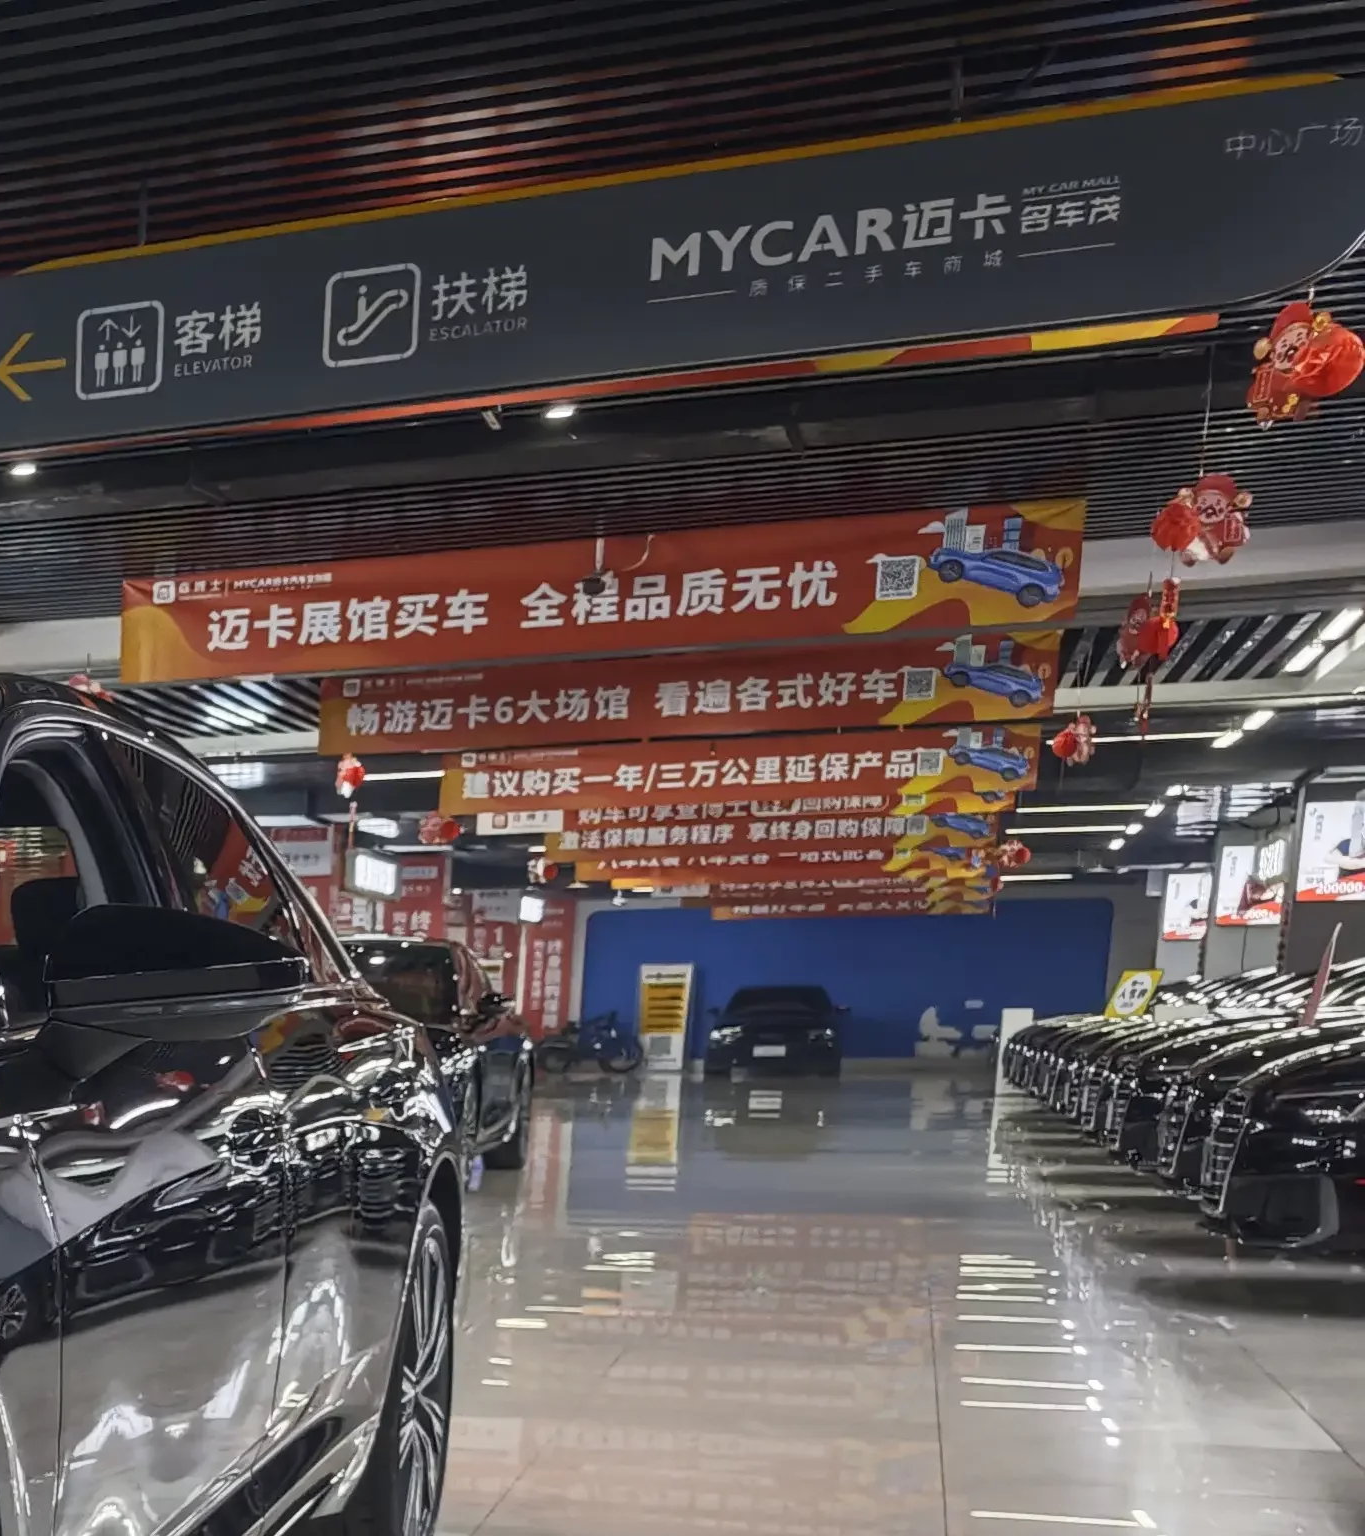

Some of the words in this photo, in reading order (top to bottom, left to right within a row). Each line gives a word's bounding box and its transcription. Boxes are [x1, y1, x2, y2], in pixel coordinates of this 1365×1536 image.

[431, 264, 529, 321] 扶梯
[748, 249, 1004, 298] 质保二手车商城
[173, 301, 262, 357] 客梯
[429, 316, 529, 342] ESCALATOR
[173, 354, 254, 378] ELEVATOR
[206, 588, 490, 653] 迈卡展馆买车
[519, 560, 839, 629] 全程品质无忧
[345, 687, 631, 736] 畅游迈卡6大场馆
[654, 668, 898, 718] 看遍各式好车
[462, 749, 916, 799] 建议购买一年/三万公里延保产品
